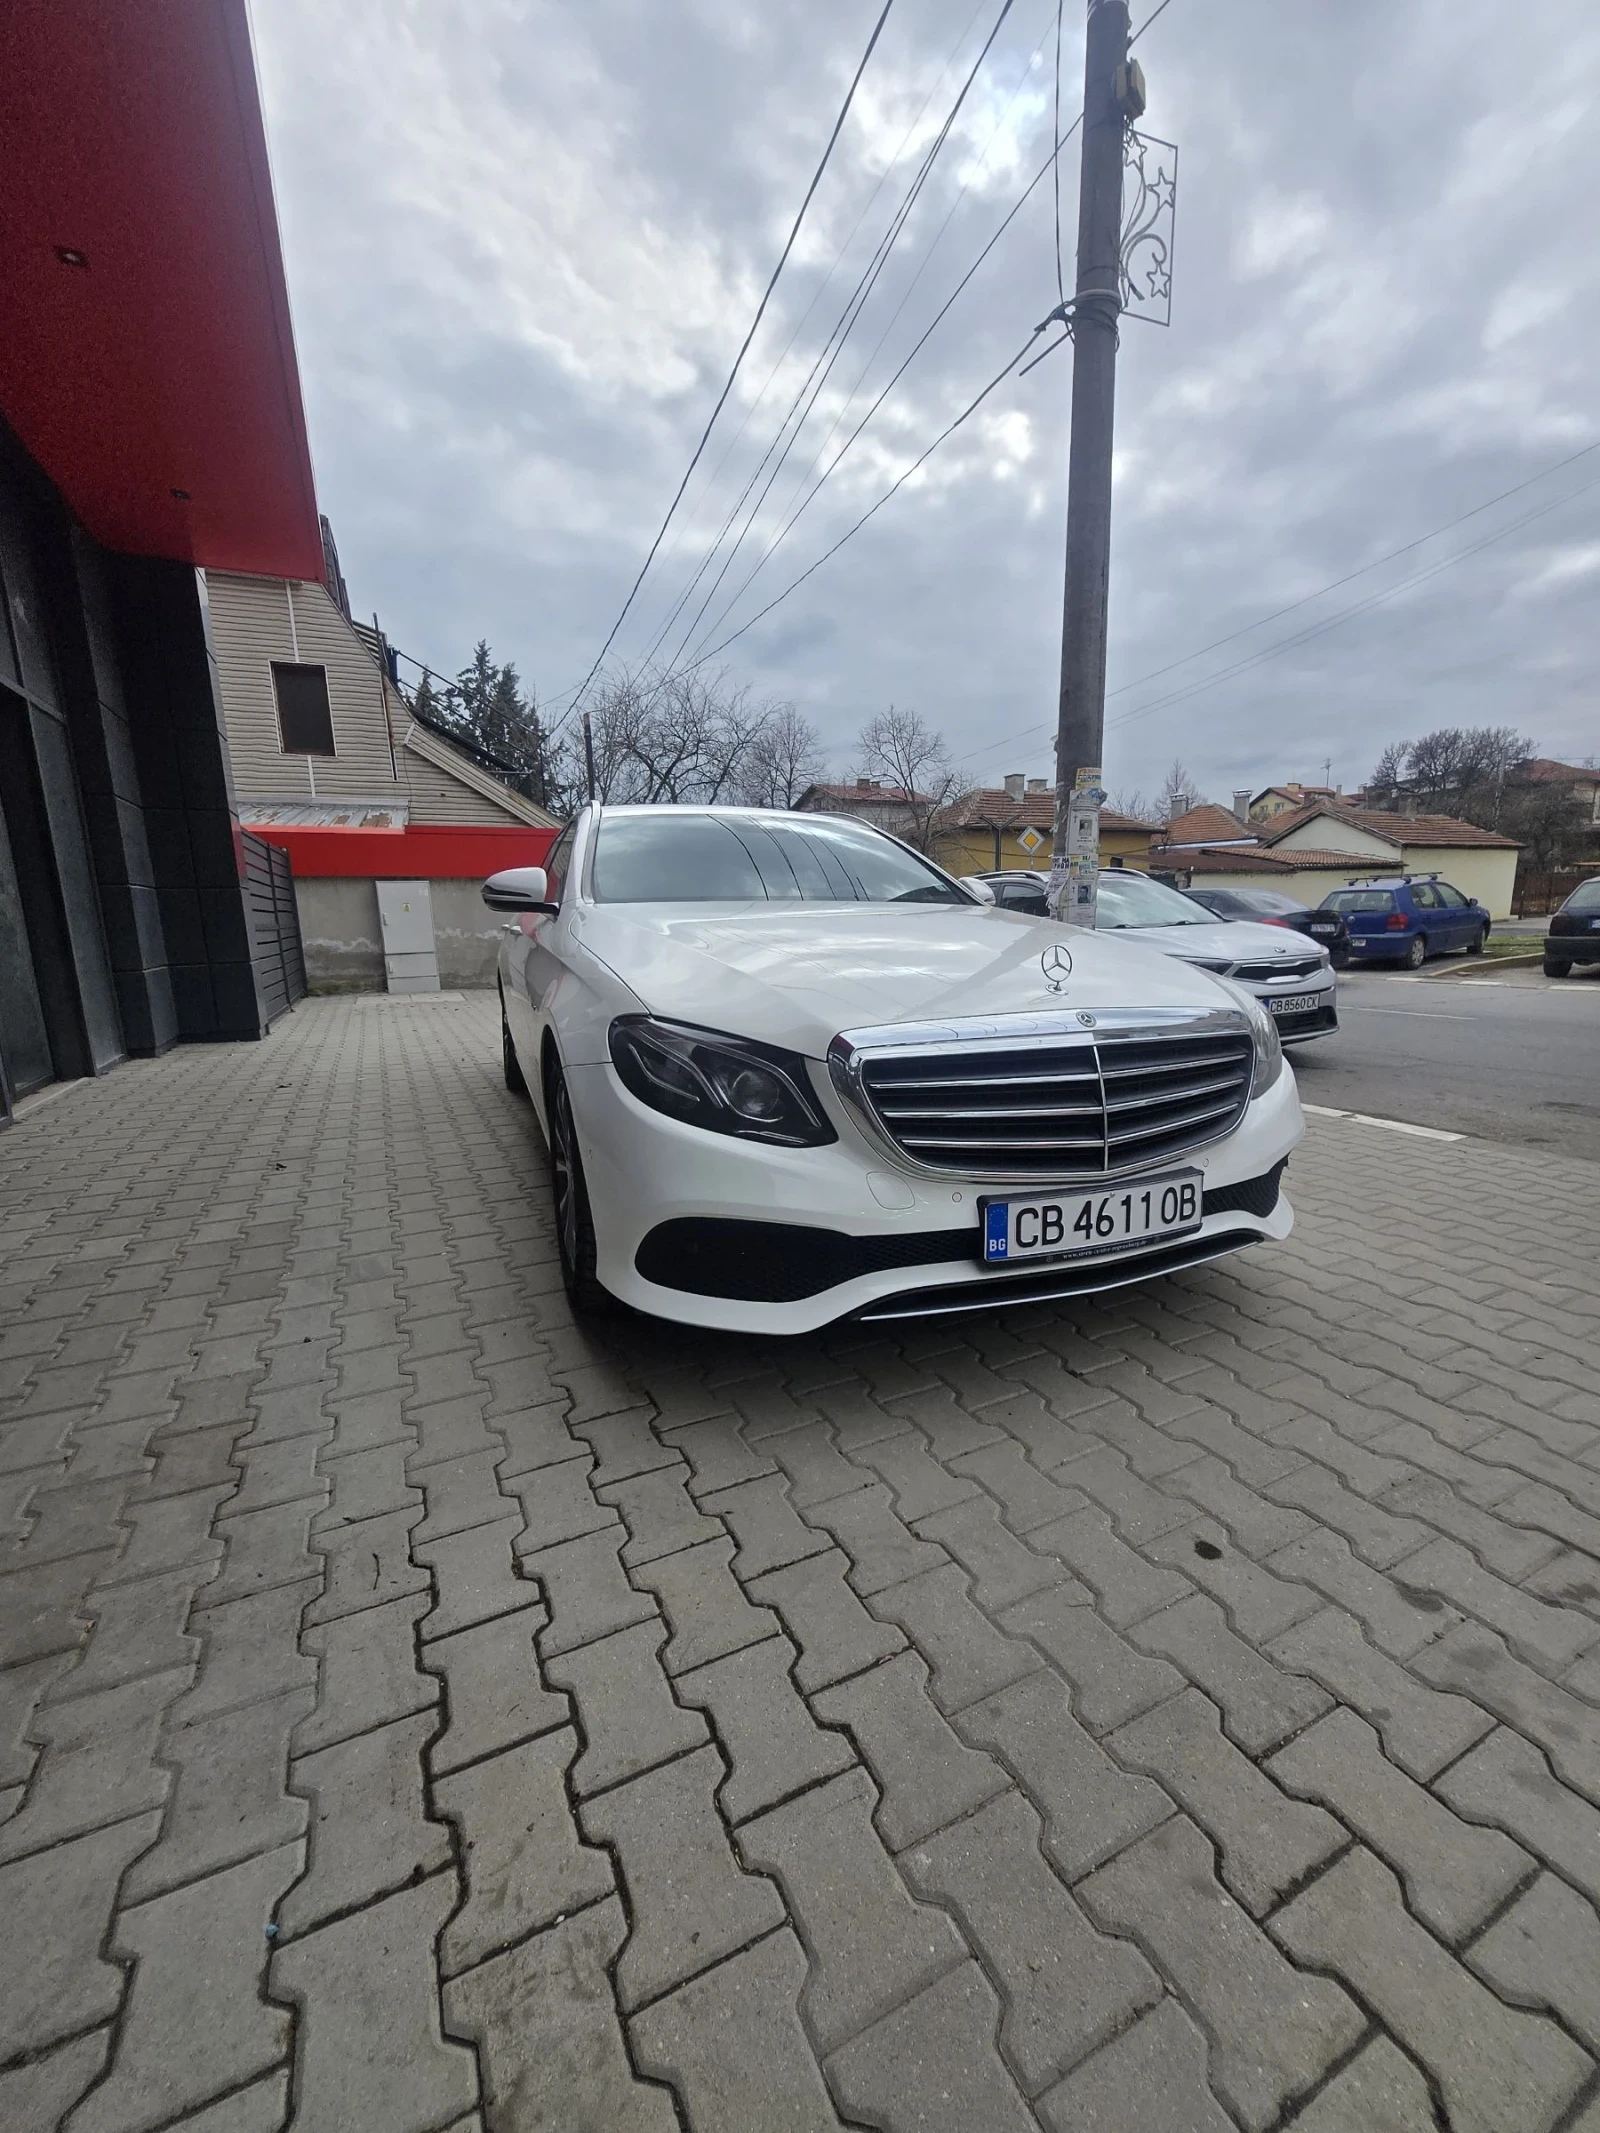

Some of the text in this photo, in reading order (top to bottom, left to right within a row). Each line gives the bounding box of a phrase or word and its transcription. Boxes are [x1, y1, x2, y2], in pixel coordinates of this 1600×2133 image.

[1271, 995, 1318, 1013] CB 8560 CK
[1015, 1183, 1196, 1248] CB 4611 OB
[989, 1238, 1006, 1252] BG
